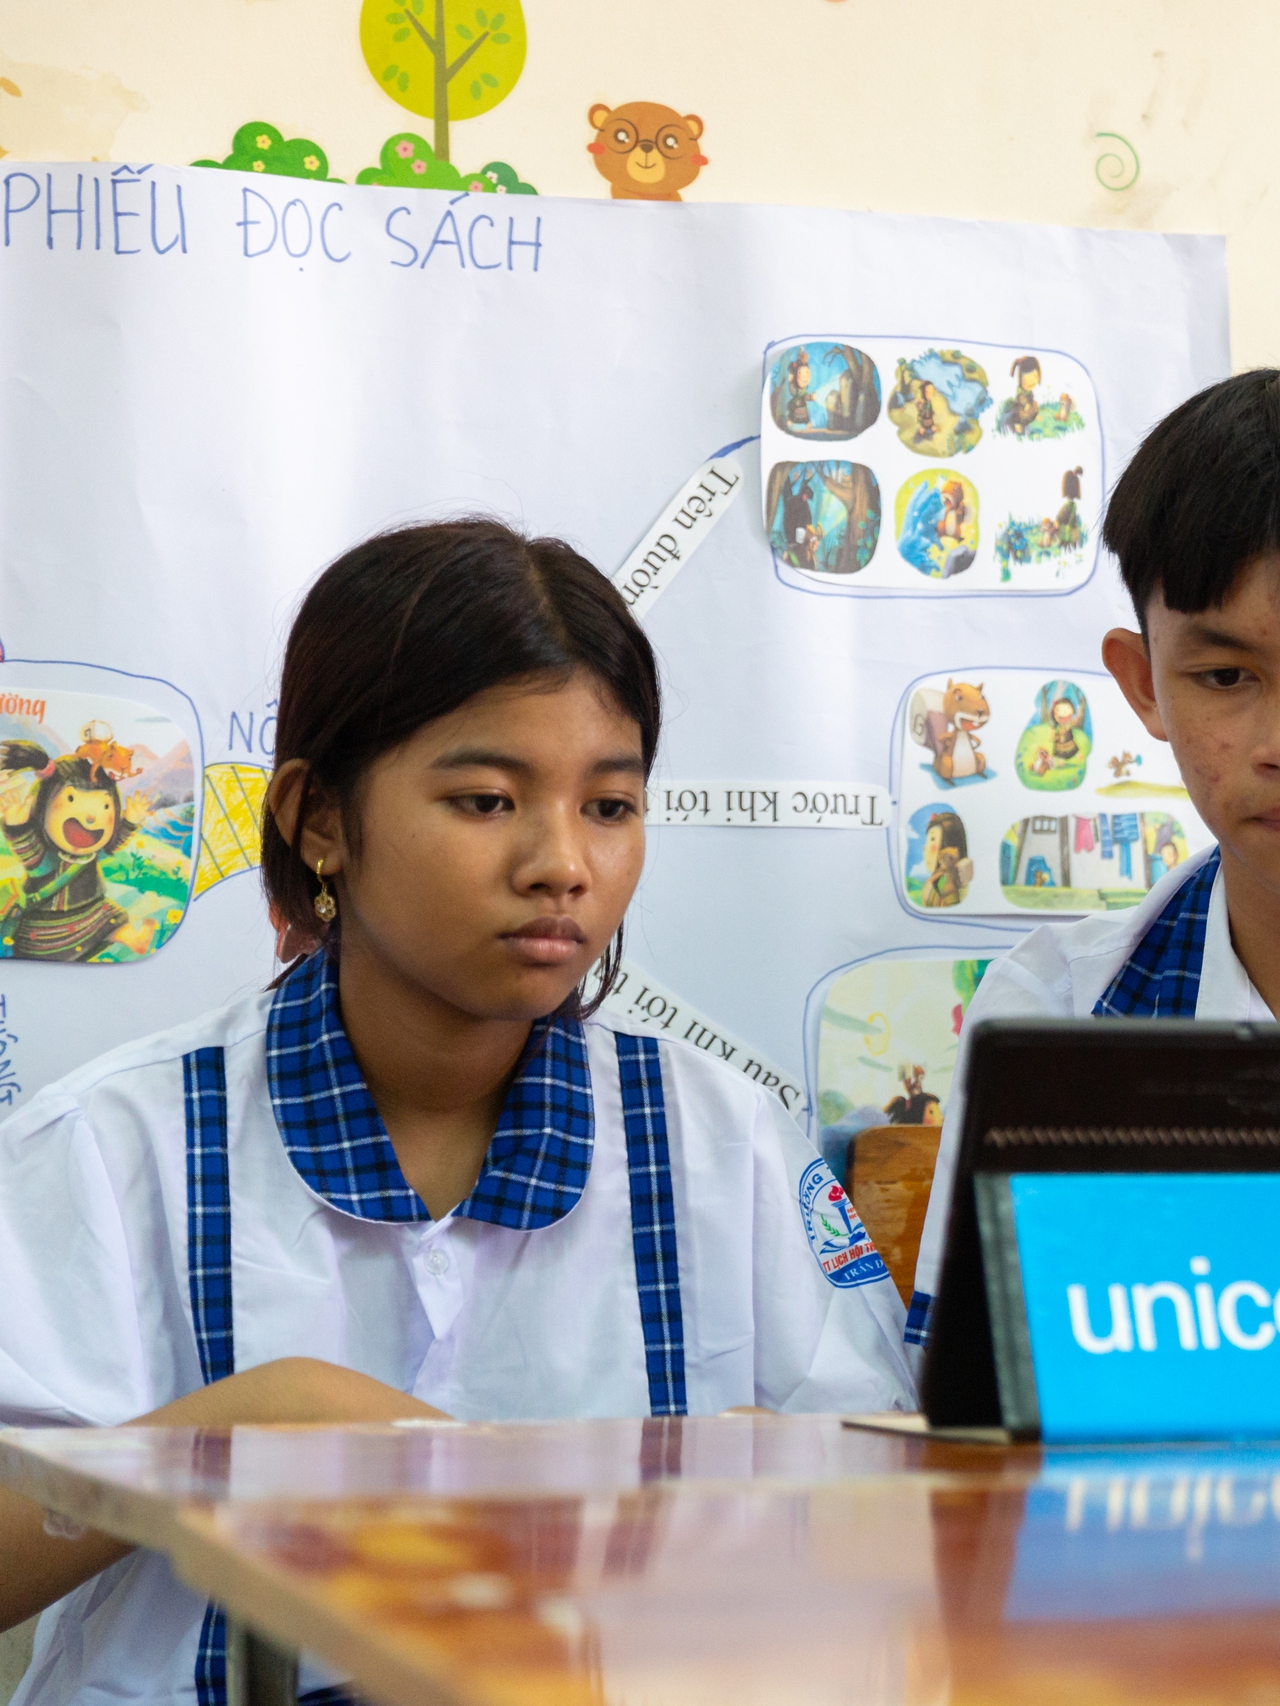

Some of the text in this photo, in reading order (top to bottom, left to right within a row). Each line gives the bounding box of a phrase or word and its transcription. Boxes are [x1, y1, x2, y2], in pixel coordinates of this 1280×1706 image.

[3, 163, 543, 273] PHIẾU ĐỌC SÁCH
[671, 465, 740, 530] Trên
[664, 788, 711, 823] tới
[724, 789, 780, 823] khi
[791, 791, 883, 826] Trước
[627, 985, 679, 1030] tới
